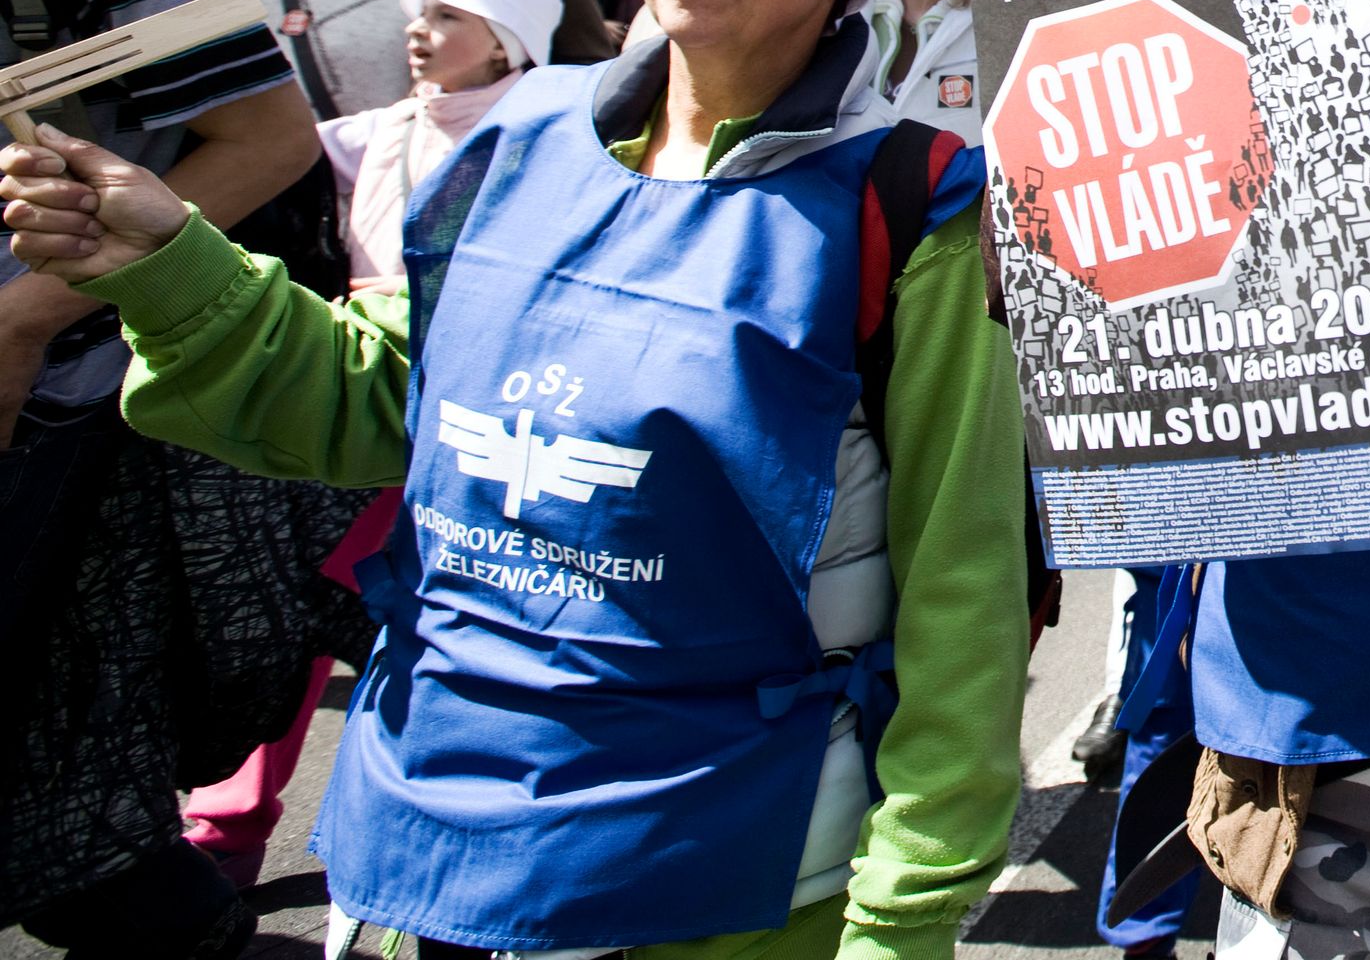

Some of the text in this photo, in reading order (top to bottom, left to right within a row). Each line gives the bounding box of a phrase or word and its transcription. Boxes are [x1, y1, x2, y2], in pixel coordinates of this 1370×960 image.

[1026, 33, 1194, 169] STOP
[1052, 134, 1232, 269] VLÁDĚ
[1057, 314, 1131, 364] 21.
[1143, 301, 1298, 359] dubna
[502, 363, 585, 418] OSŽ
[1034, 370, 1065, 397] 13
[1070, 367, 1125, 396] hod.
[1130, 361, 1218, 391] Praha,
[1222, 341, 1366, 384] Václavské
[413, 502, 665, 582] ODBOROVÉ SDRUŽENÍ
[435, 542, 606, 602] ŽELEZNIČÁŘŮ
